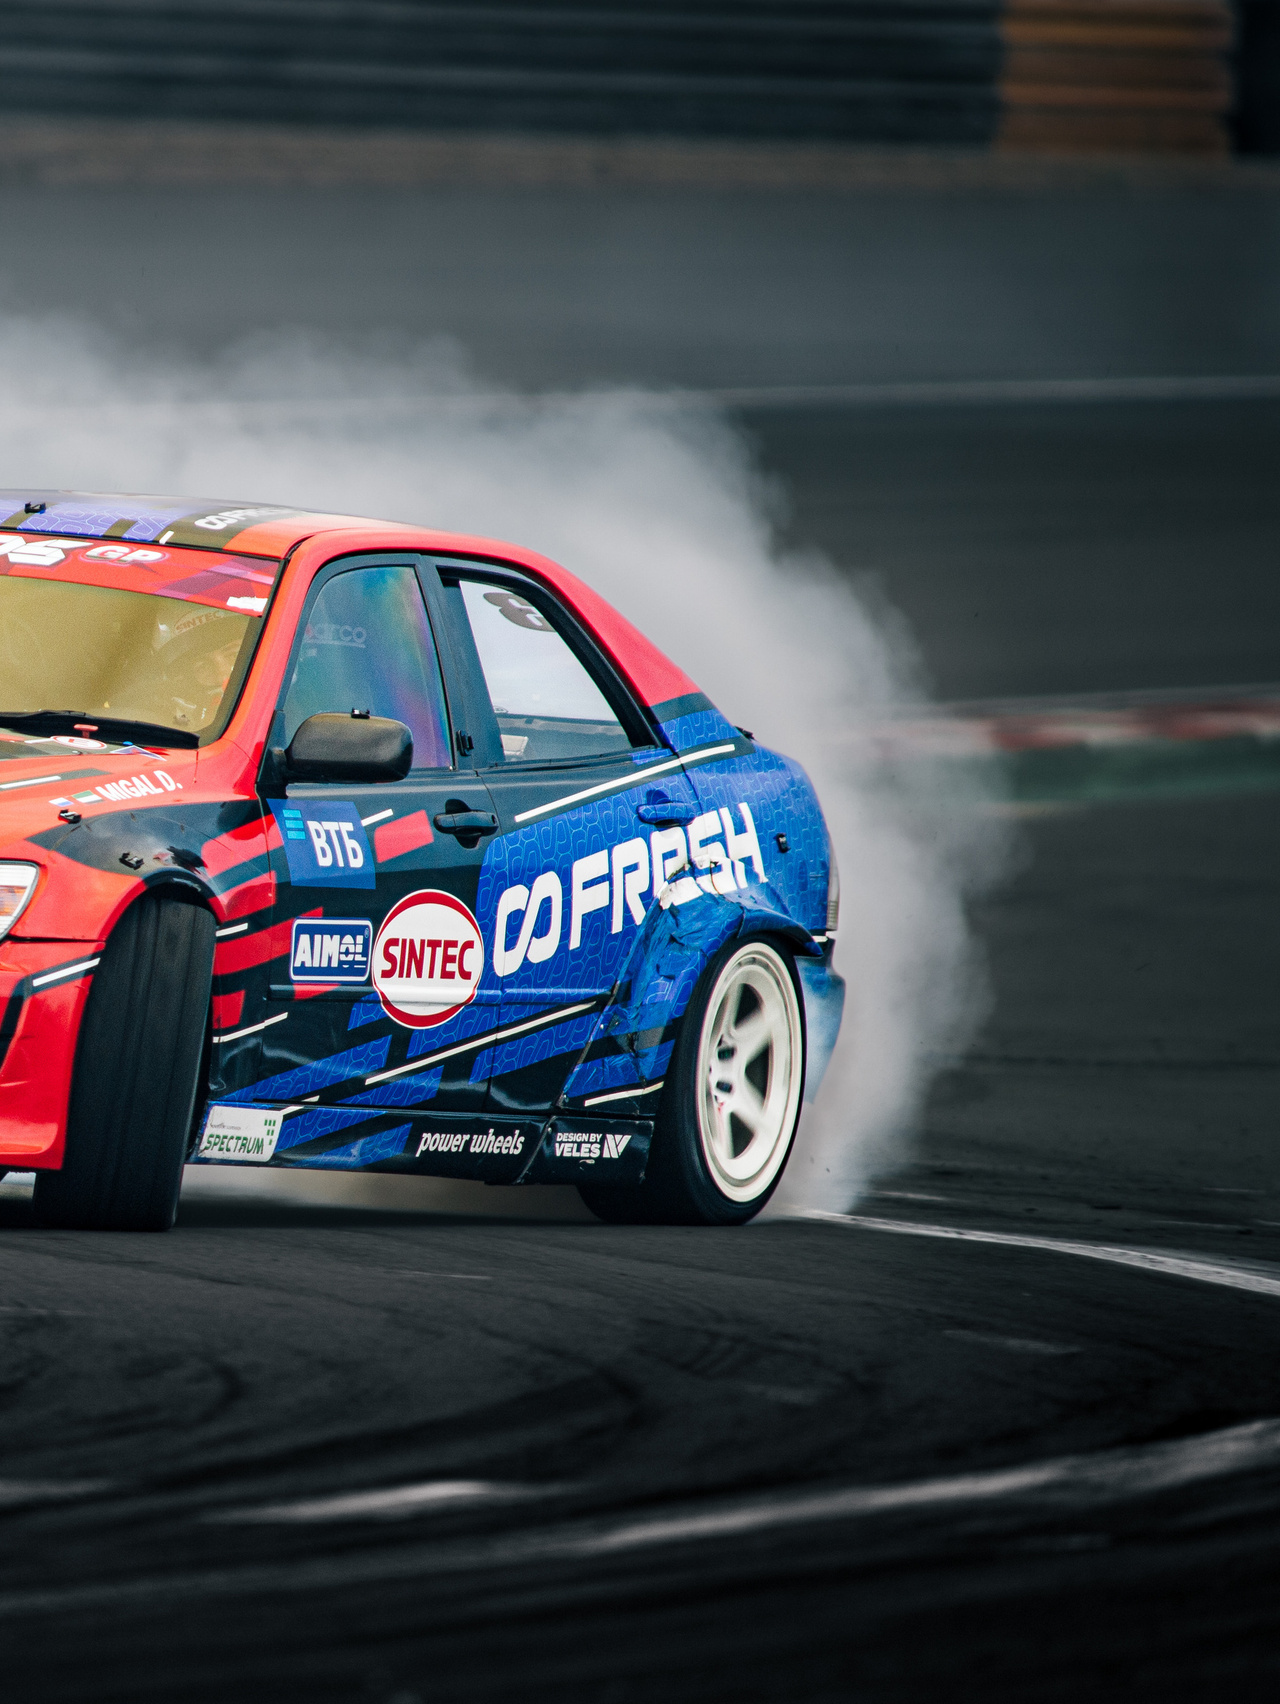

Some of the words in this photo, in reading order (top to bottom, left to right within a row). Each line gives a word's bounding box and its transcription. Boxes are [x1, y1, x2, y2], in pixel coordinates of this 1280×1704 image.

[85, 545, 163, 563] GP
[95, 774, 164, 801] MIGAL
[153, 770, 183, 791] D.
[306, 820, 364, 869] ВТБ
[293, 934, 367, 969] AIMOL
[380, 937, 475, 981] SINTEC
[204, 1133, 265, 1155] SPECTRUM
[416, 1132, 470, 1157] power
[470, 1129, 525, 1155] wheels
[555, 1143, 601, 1158] VELES
[556, 1133, 590, 1143] DESIGN
[590, 1134, 603, 1143] BY
